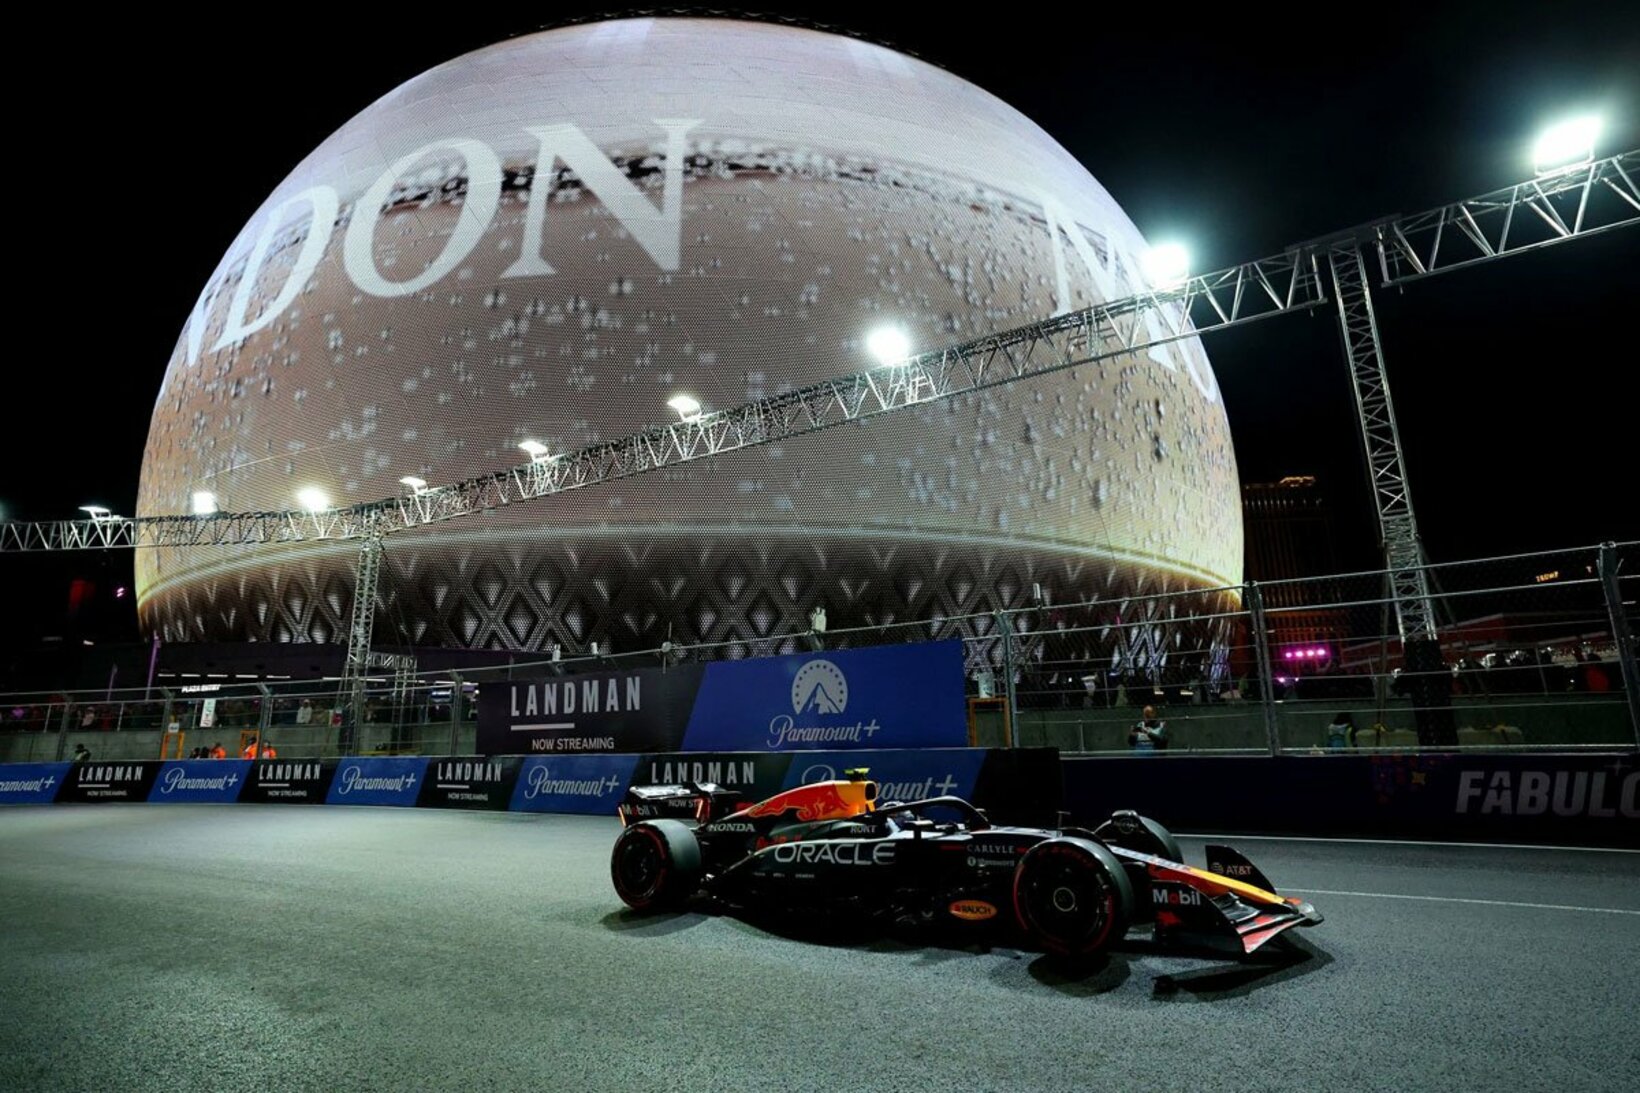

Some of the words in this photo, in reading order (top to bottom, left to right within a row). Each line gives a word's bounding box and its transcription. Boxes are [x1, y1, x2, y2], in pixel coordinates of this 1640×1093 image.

[510, 676, 641, 717] LANDMAN
[766, 714, 881, 748] Paramount+
[532, 738, 556, 750] NOW
[557, 737, 615, 750] STREAMING
[78, 766, 143, 782] LANDMAN
[160, 767, 239, 794] Paramount+
[259, 763, 321, 780] LANDMAN
[338, 765, 417, 795] Paramount+
[436, 762, 503, 782] LANDMAN
[651, 760, 756, 785] LANDMAN
[524, 765, 620, 799] Paramount+
[461, 793, 488, 801] STREAMING
[706, 822, 756, 833] HONDA
[774, 842, 896, 866] ORACLE
[966, 844, 1015, 854] CARLYLE
[1225, 865, 1253, 875] AT&T
[1152, 887, 1201, 906] Mobil
[961, 905, 991, 915] RAUCH
